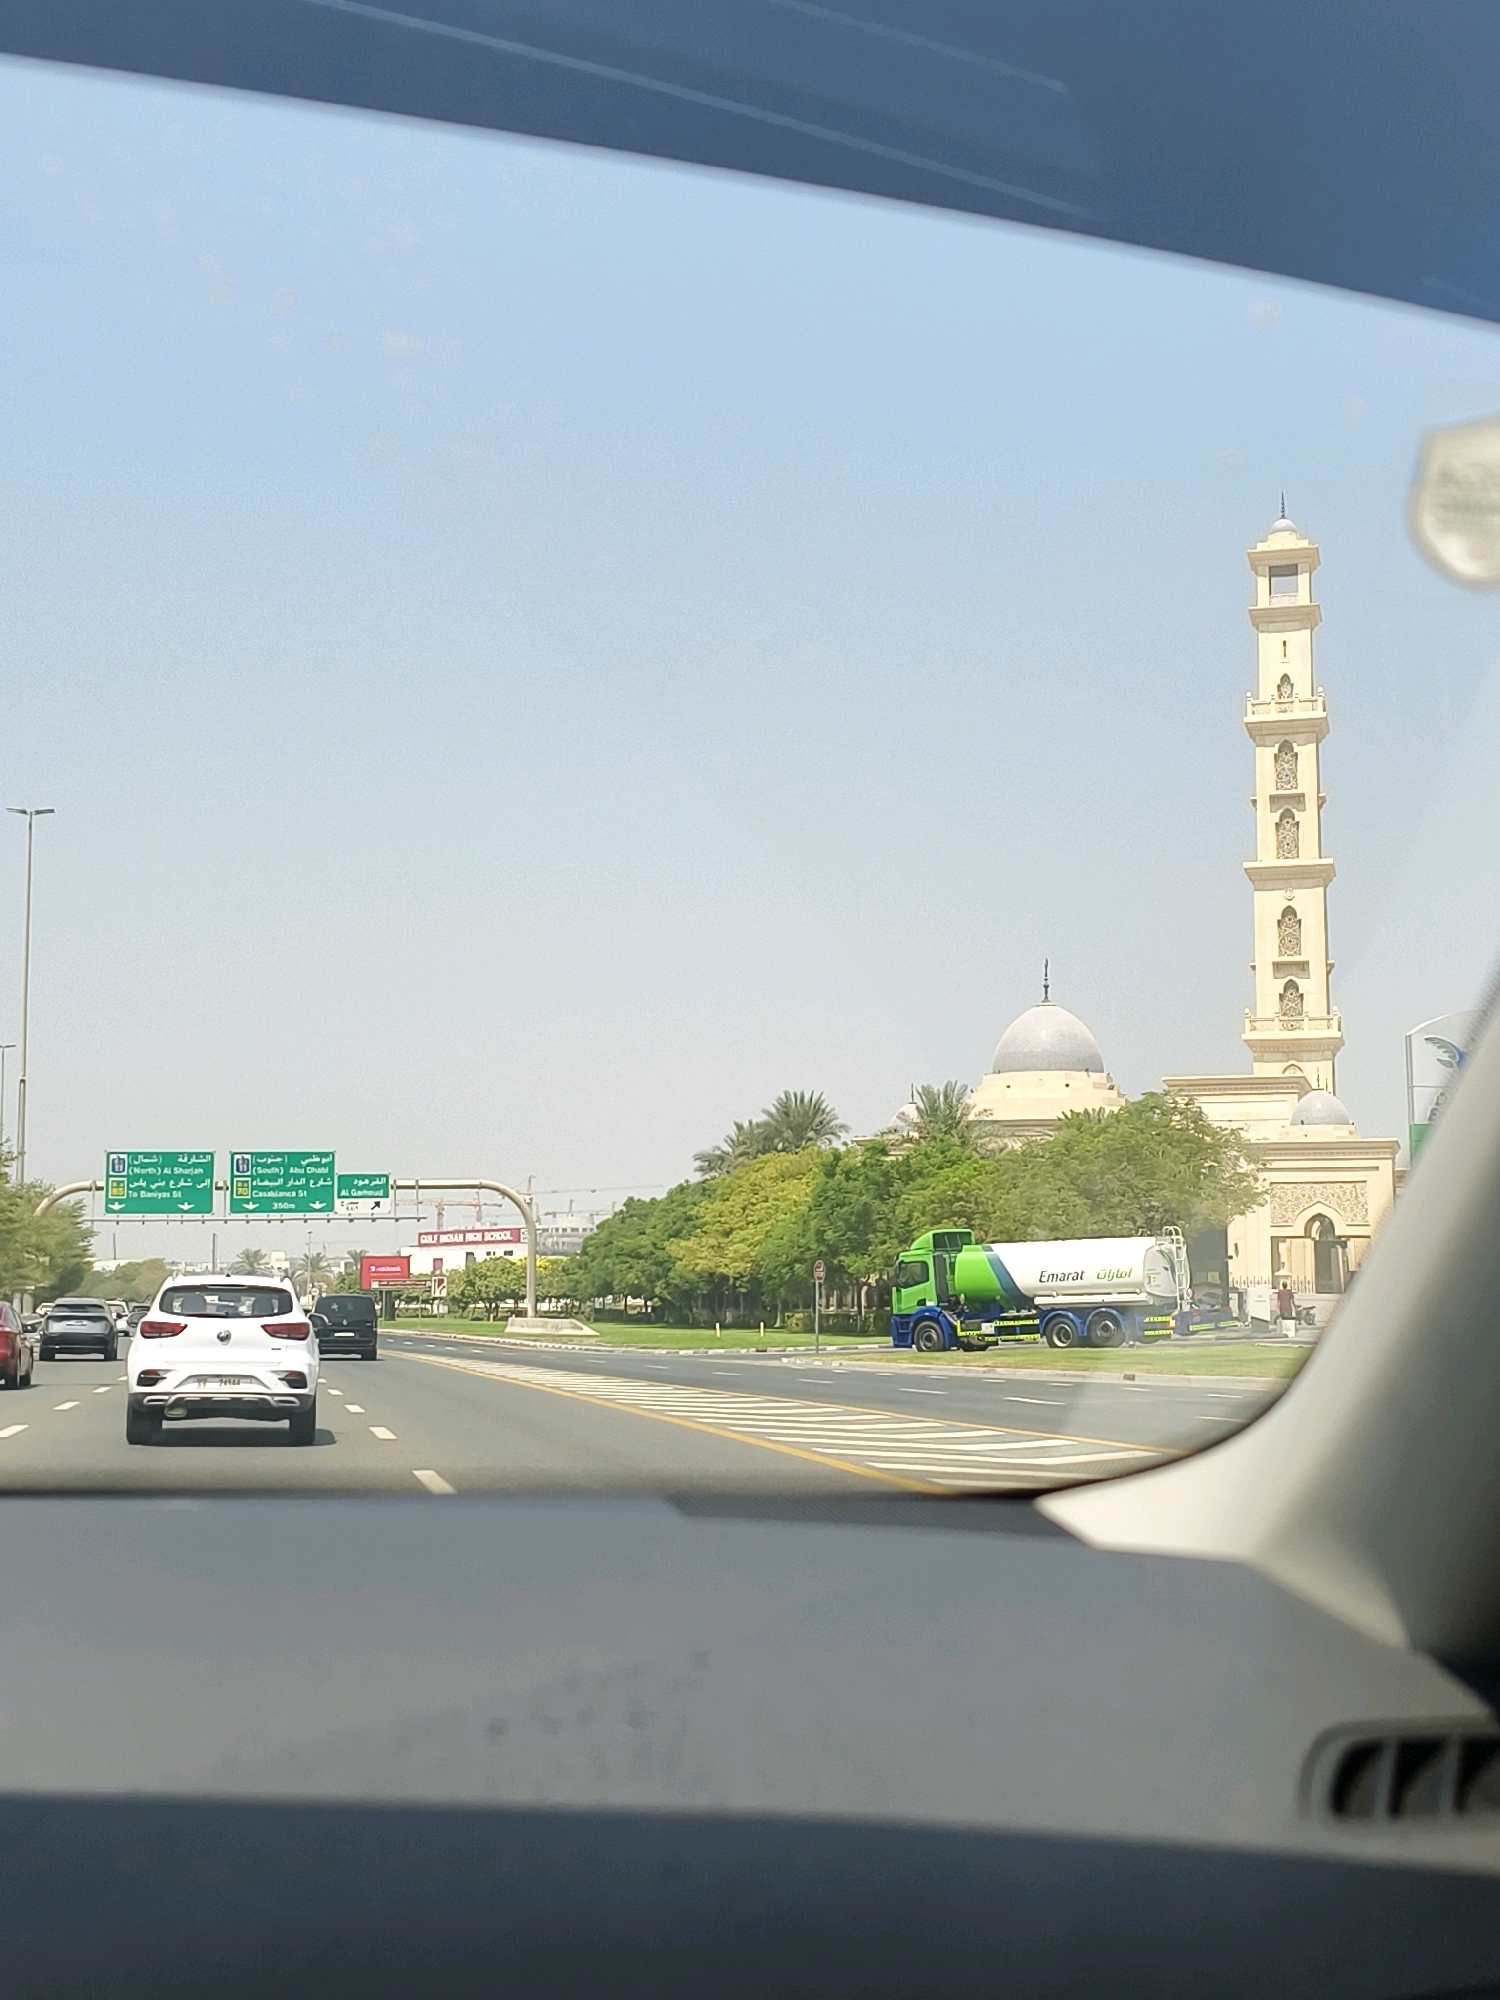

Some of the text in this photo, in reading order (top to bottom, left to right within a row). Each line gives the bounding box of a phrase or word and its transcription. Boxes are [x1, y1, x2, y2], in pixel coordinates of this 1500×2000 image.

[178, 1154, 211, 1165] الشارقة
[252, 1166, 284, 1175] (South)
[169, 1178, 193, 1189] شارع
[309, 1178, 332, 1188] شارع
[128, 1190, 181, 1199] To Baniyas St
[340, 1189, 350, 1197] Al
[484, 1230, 514, 1241] SCHOOL
[1039, 1269, 1085, 1284] Emarat
